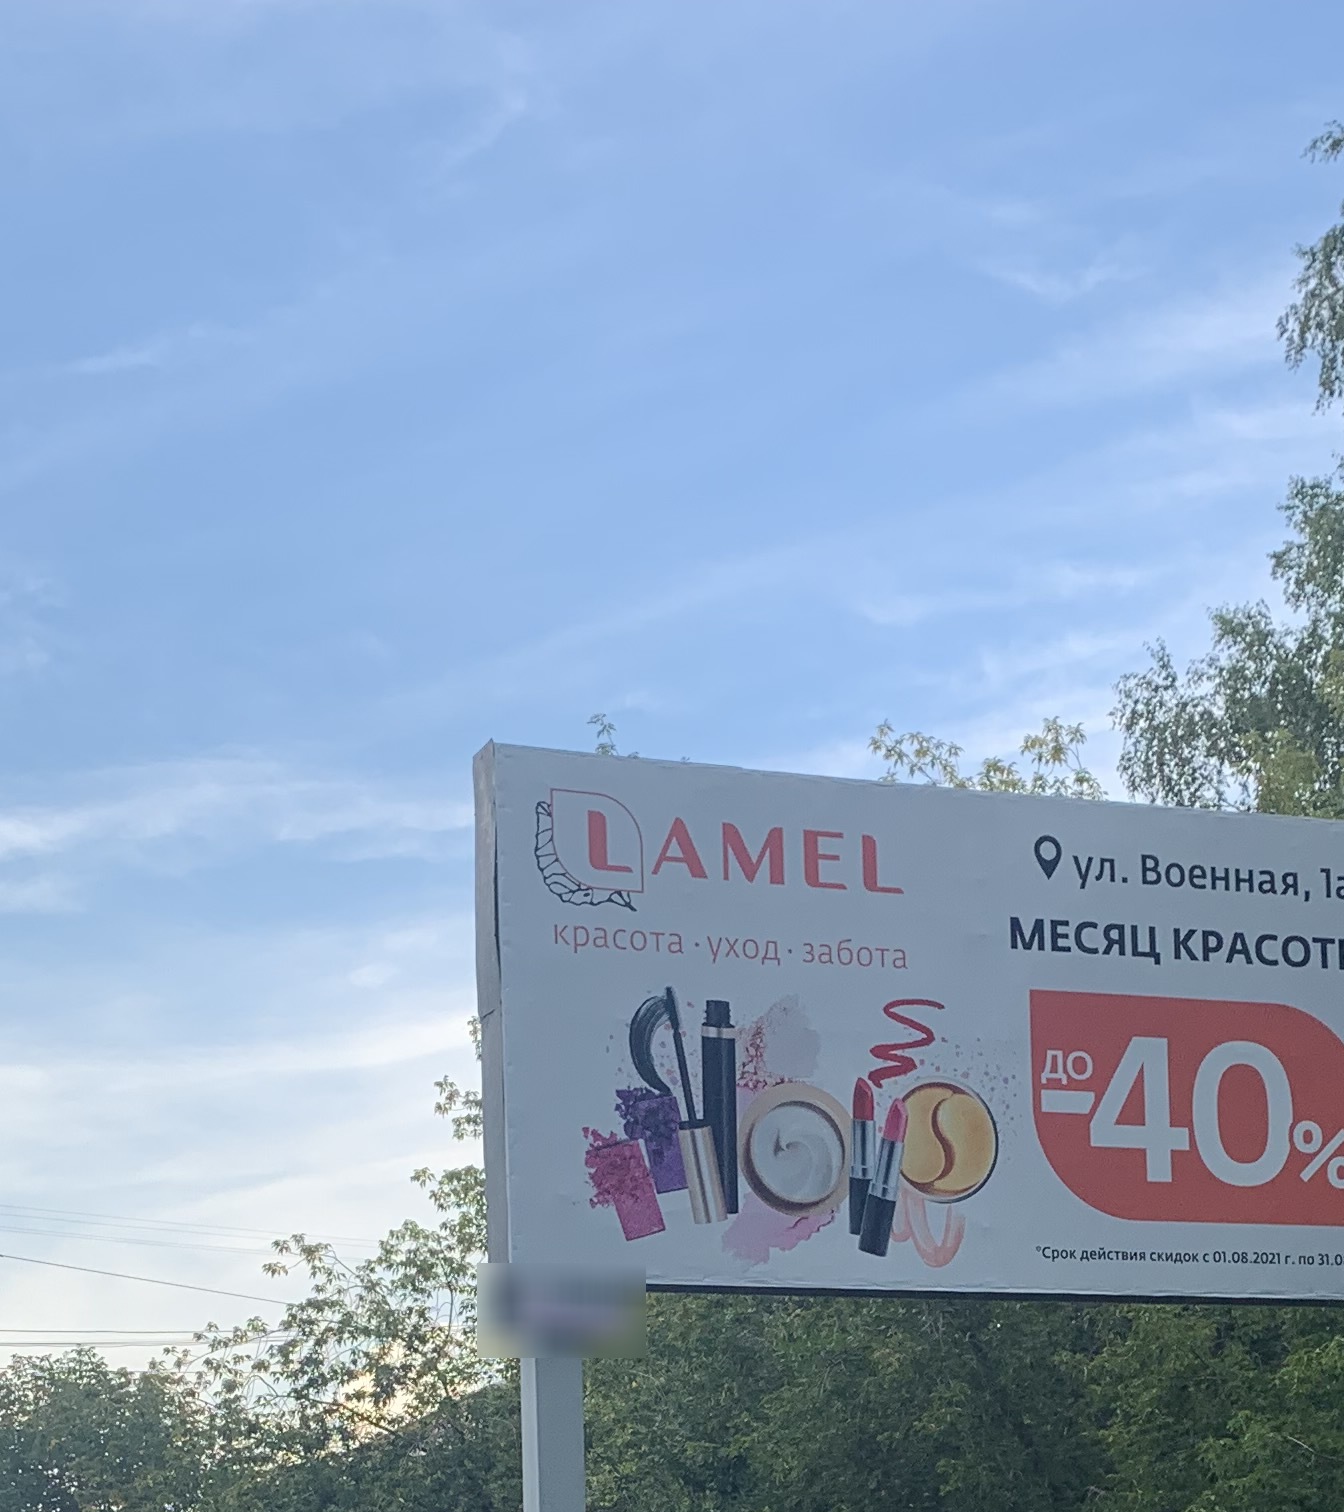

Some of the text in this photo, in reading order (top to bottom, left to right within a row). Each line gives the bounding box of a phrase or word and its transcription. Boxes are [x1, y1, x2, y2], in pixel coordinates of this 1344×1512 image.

[587, 809, 904, 894] LAMEL
[1072, 854, 1128, 889] ул.
[1141, 854, 1311, 902] Военная,
[554, 923, 909, 969] красота уход забота
[1009, 916, 1161, 965] МЕСЯЦ
[1080, 1247, 1146, 1262] действия
[1150, 1250, 1199, 1264] скидок
[1202, 1252, 1210, 1263] с
[1213, 1250, 1281, 1264] 01.08.2021
[1284, 1254, 1296, 1265] г.
[1298, 1255, 1315, 1266] по
